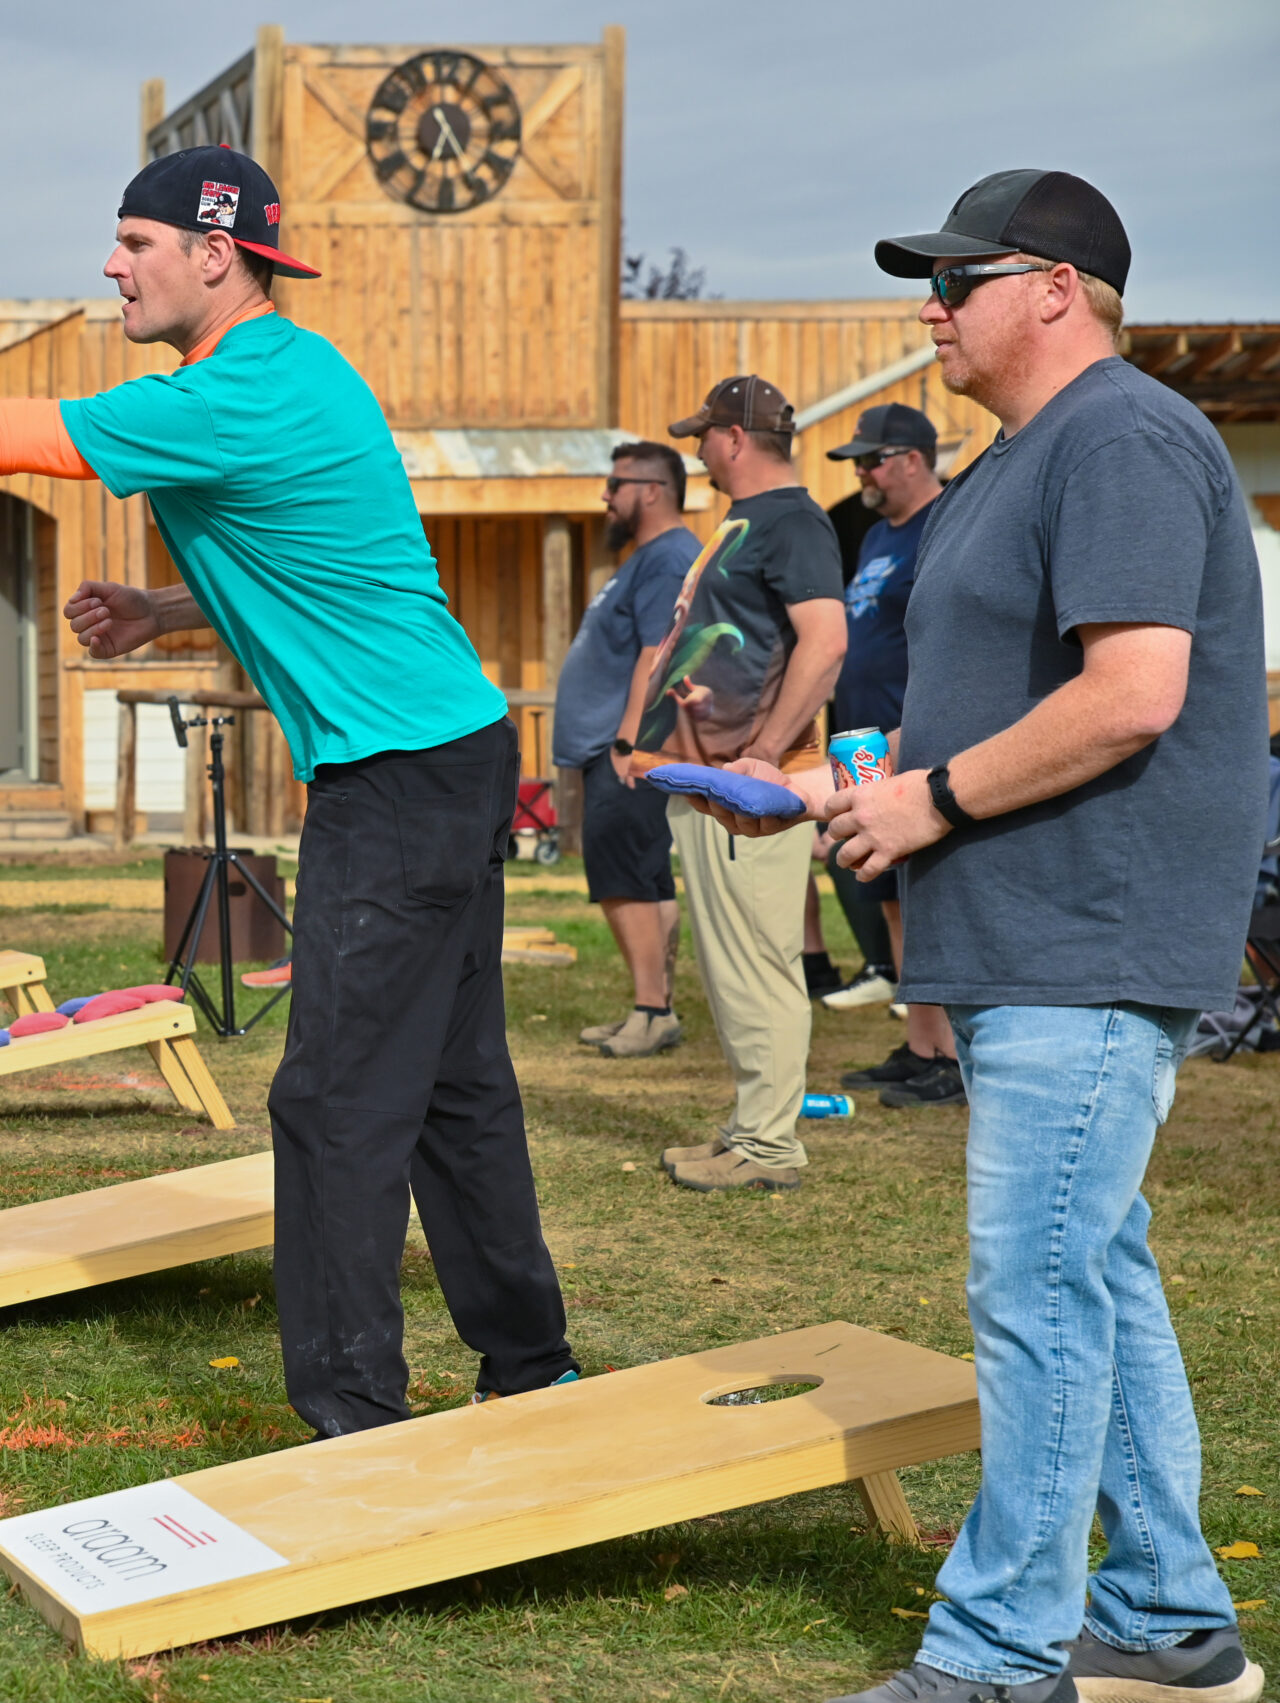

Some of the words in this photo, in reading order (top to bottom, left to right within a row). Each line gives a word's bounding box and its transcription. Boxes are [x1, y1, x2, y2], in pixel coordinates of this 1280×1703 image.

[24, 1531, 62, 1558] SLEEP
[51, 1552, 107, 1590] PRODUCTS
[62, 1519, 169, 1581] araam
